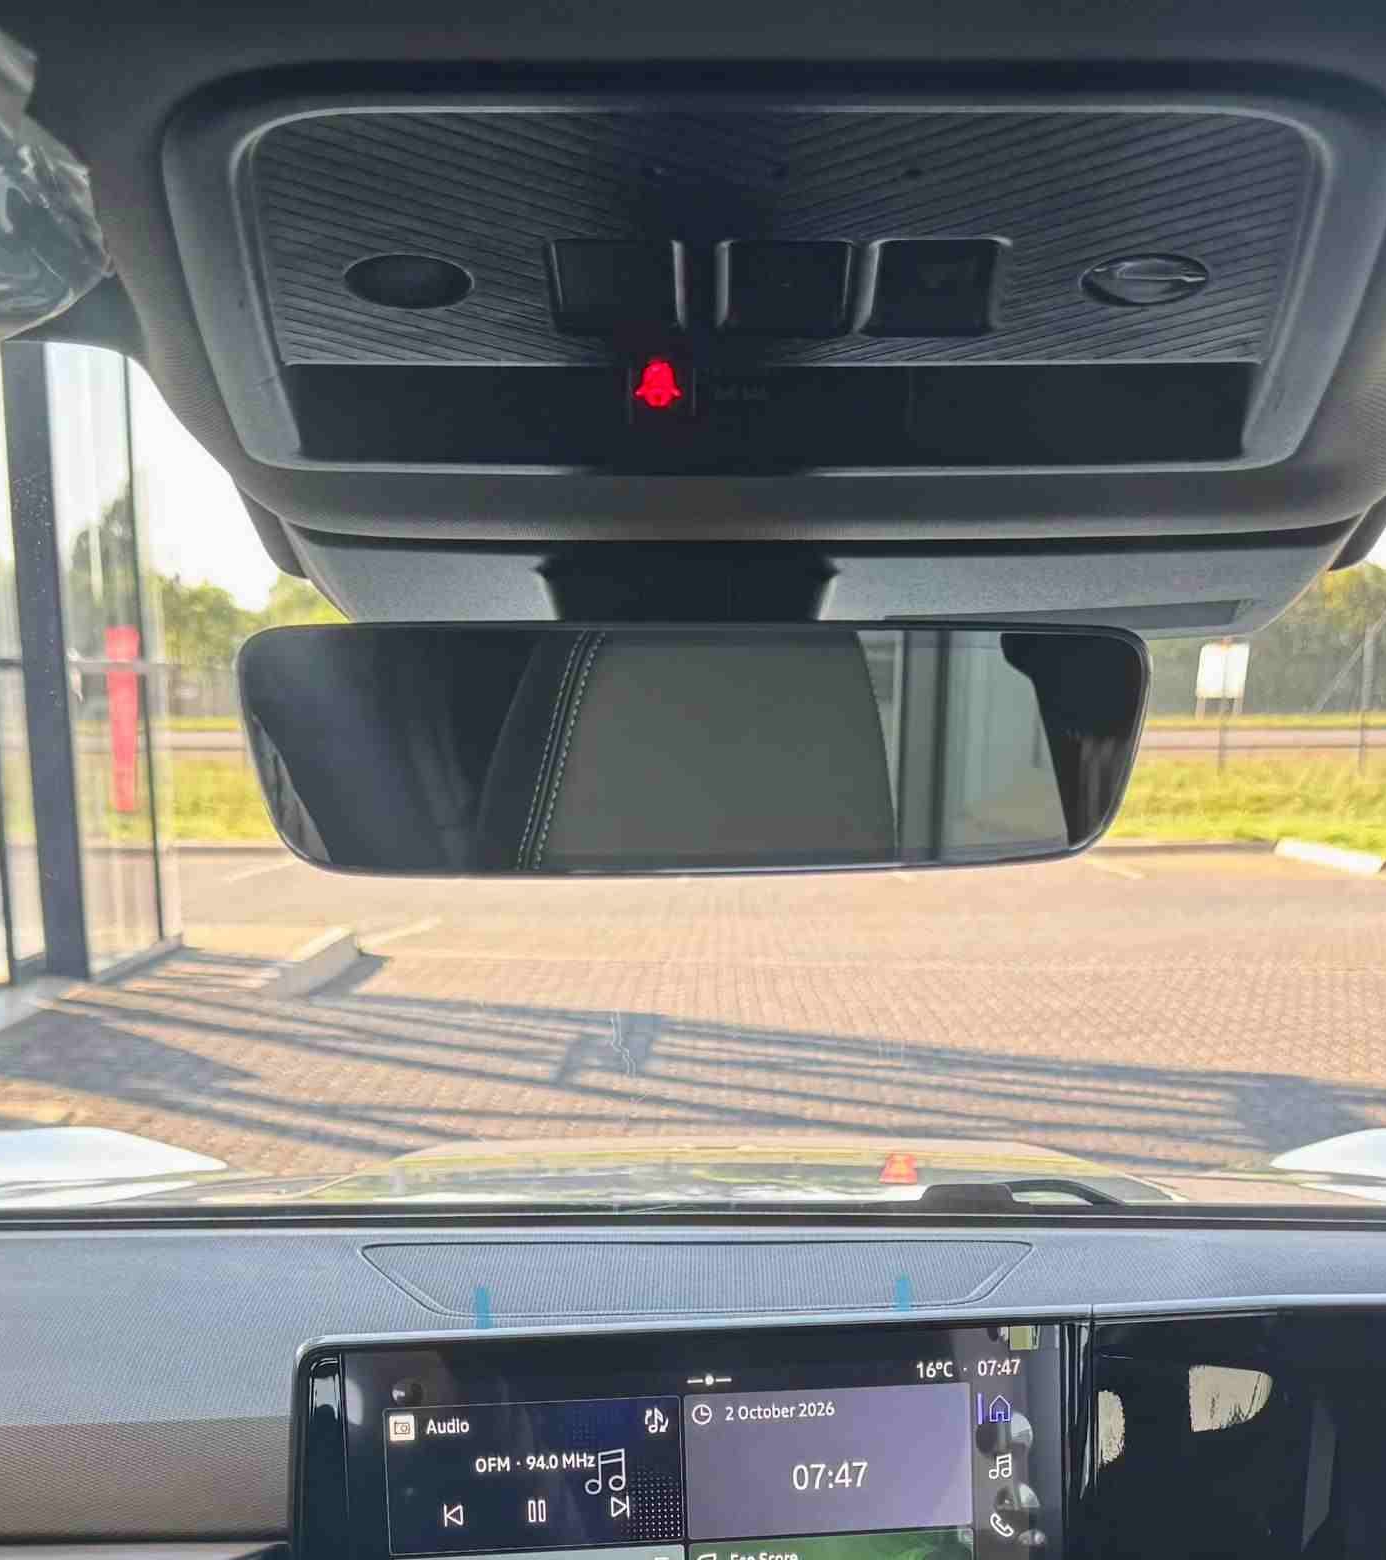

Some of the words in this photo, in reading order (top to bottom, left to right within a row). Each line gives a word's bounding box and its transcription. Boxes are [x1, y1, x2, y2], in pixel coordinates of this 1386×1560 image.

[977, 1359, 1021, 1376] 07:47
[724, 1406, 735, 1421] 2
[738, 1404, 797, 1421] October
[800, 1402, 835, 1417] 2026
[426, 1418, 470, 1434] Audio
[475, 1457, 511, 1473] OFM
[525, 1454, 559, 1471] 94.0
[562, 1453, 596, 1469] MHz
[792, 1461, 869, 1491] 07:47
